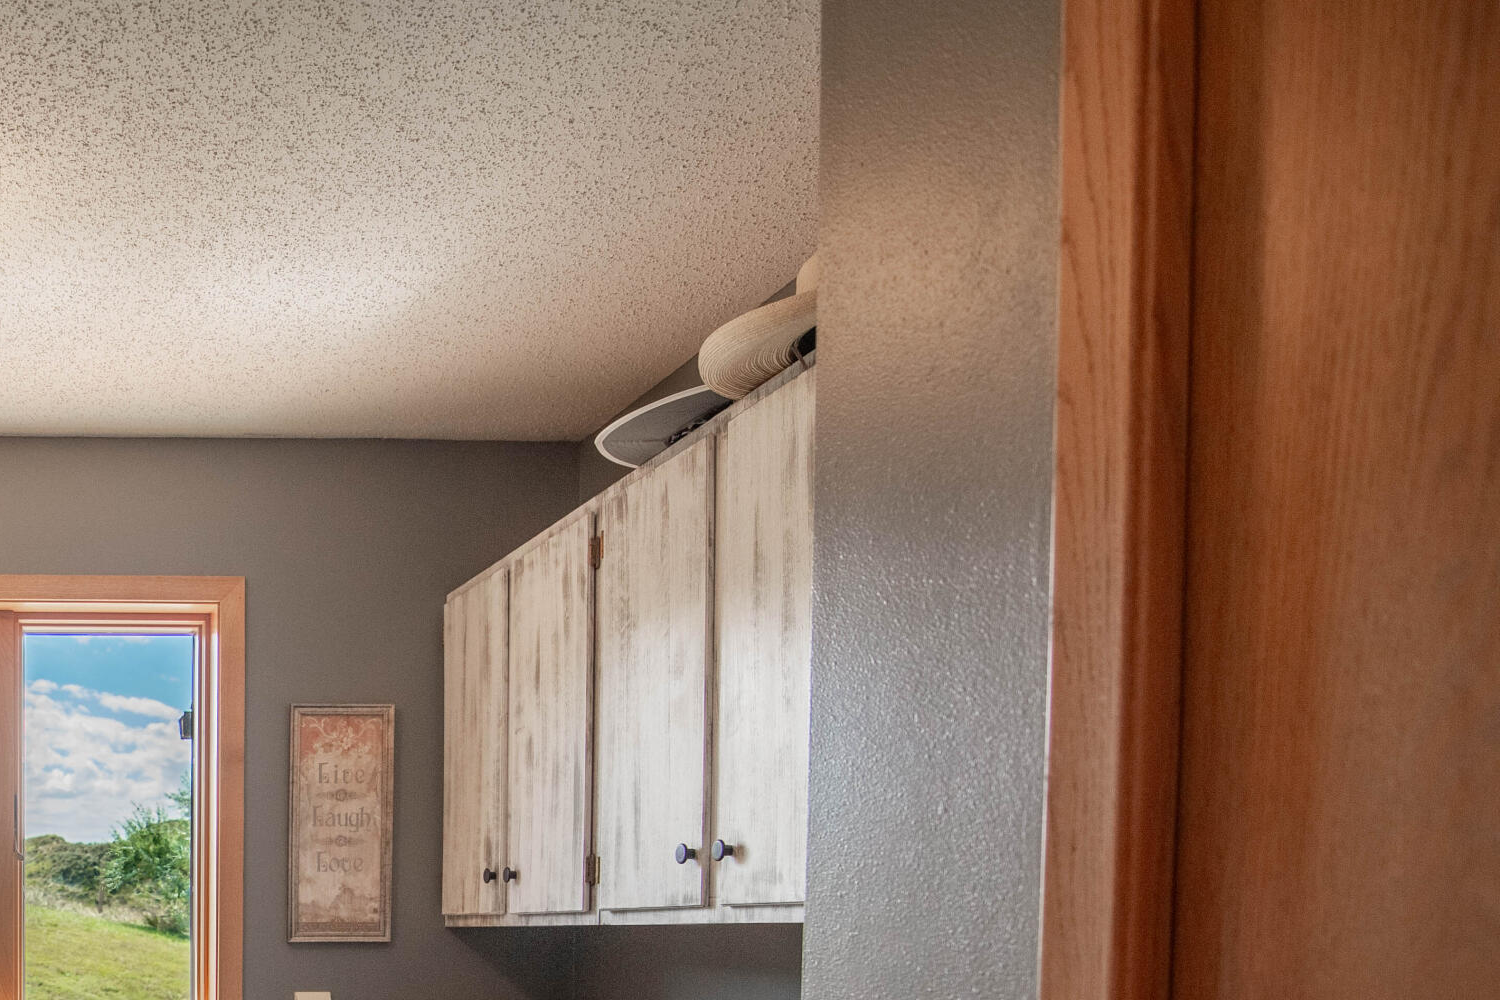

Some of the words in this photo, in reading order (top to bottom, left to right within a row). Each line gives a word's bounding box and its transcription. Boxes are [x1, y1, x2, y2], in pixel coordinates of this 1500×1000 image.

[317, 762, 365, 784] Live
[312, 805, 372, 832] Laugh
[316, 851, 364, 872] Love
